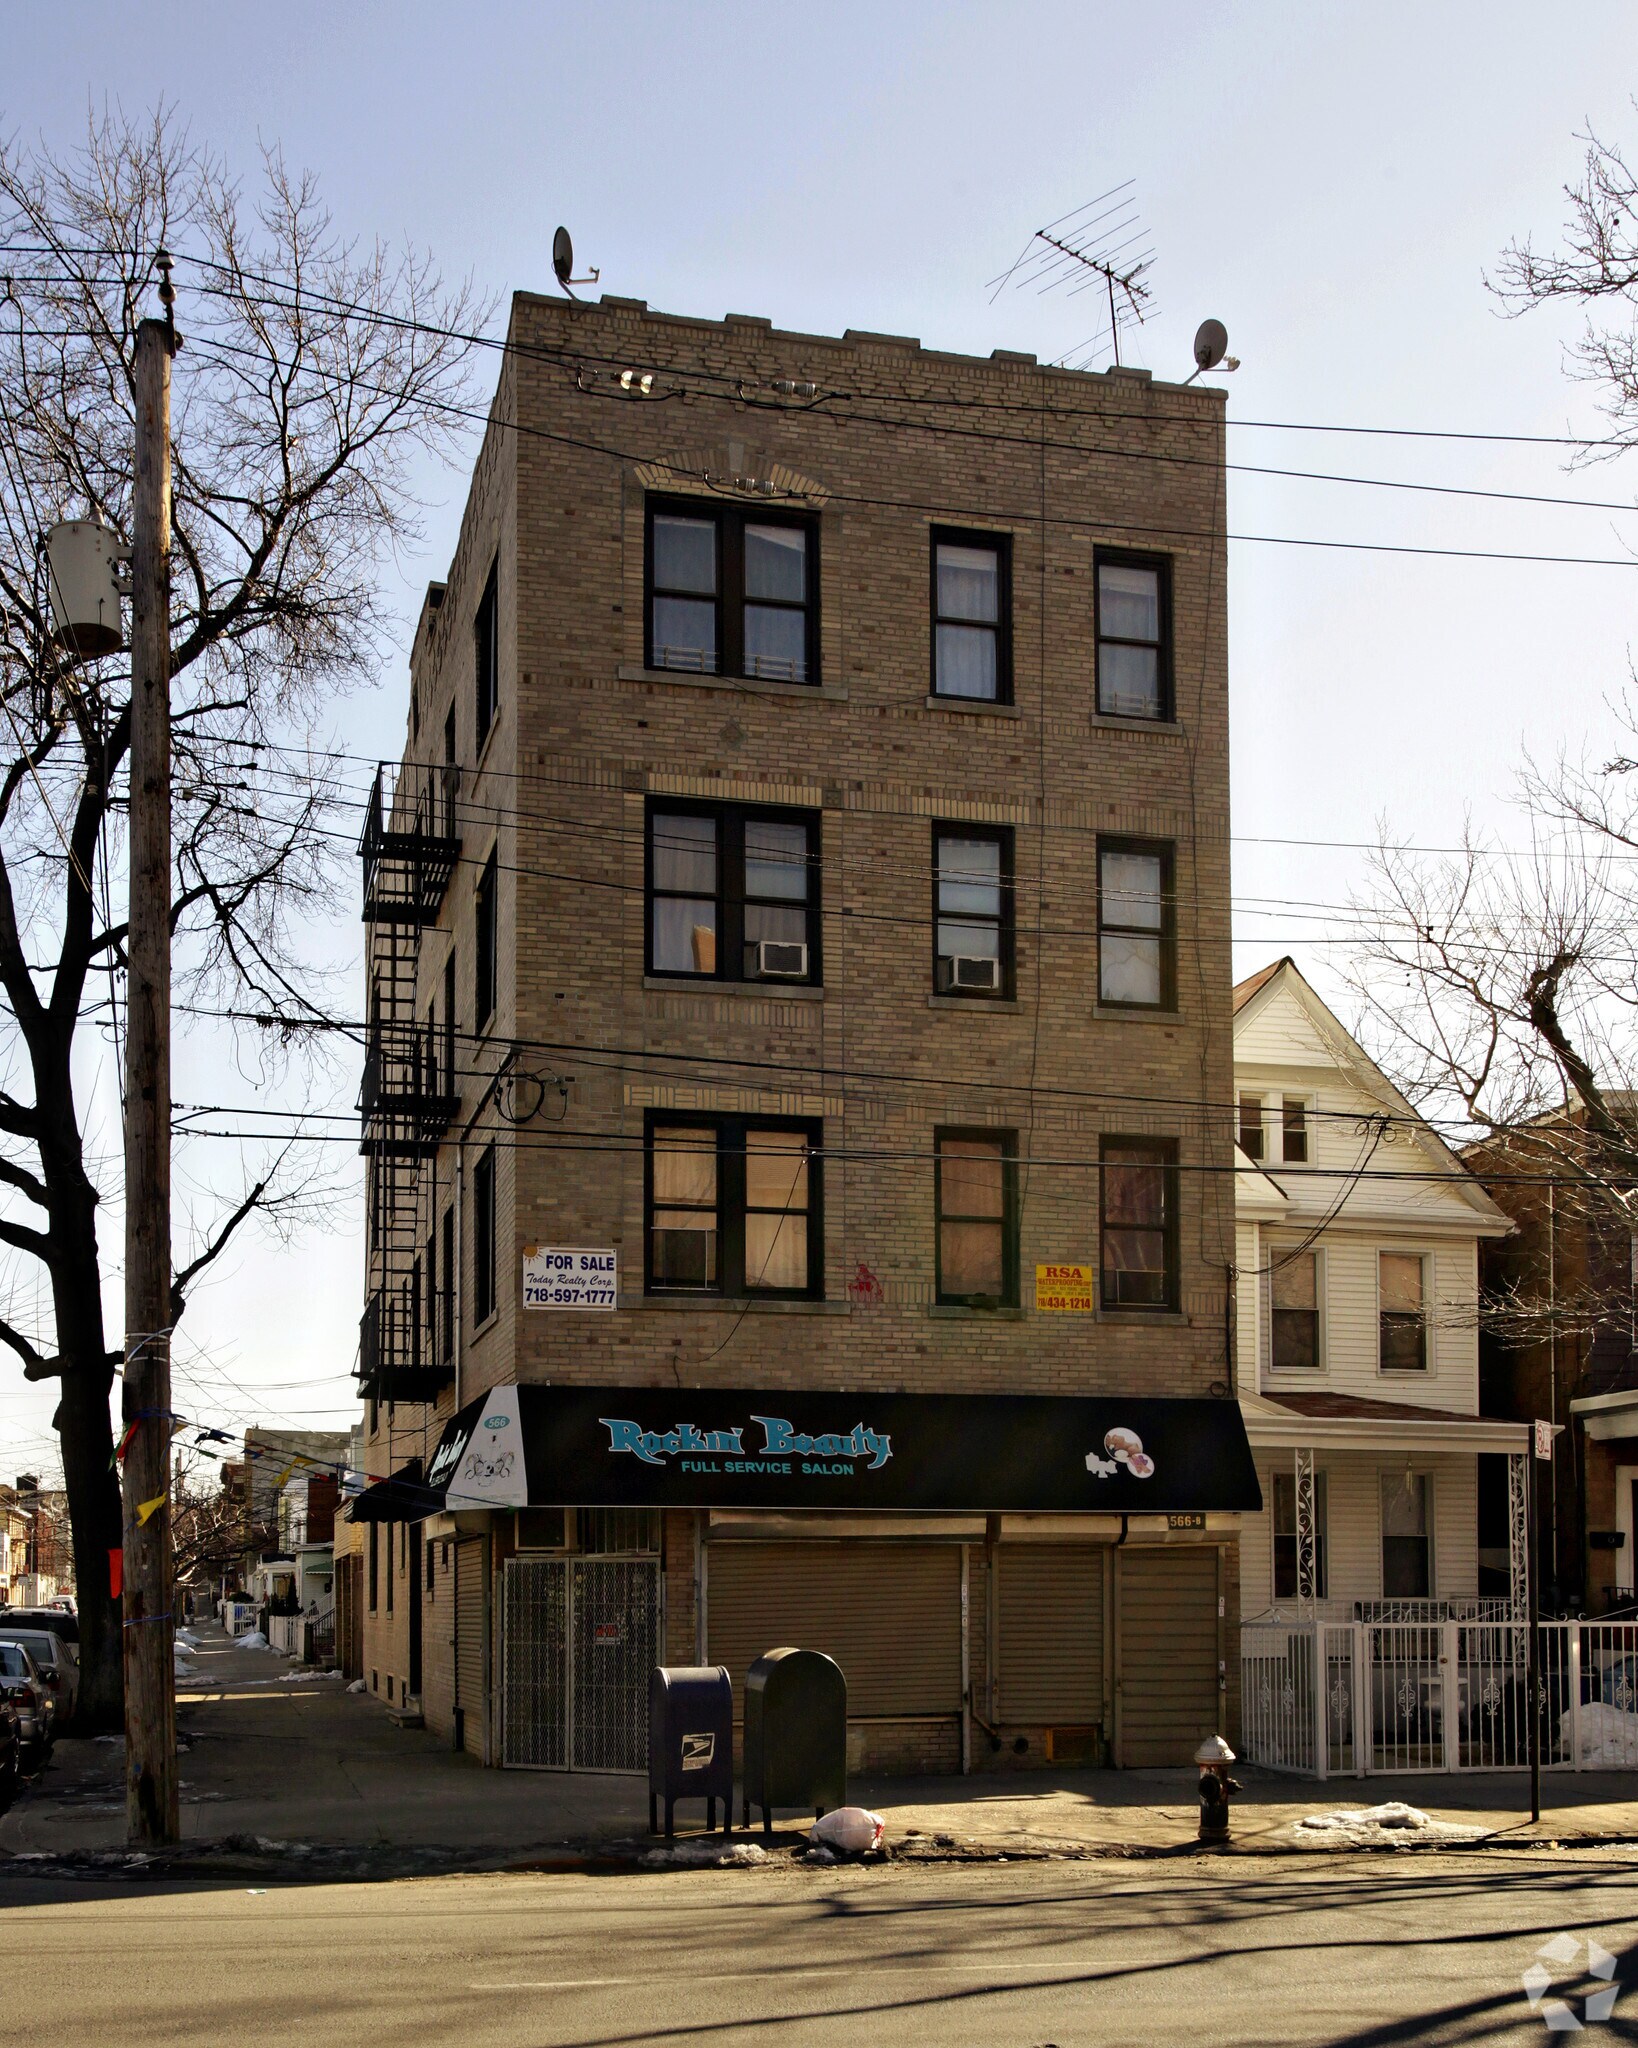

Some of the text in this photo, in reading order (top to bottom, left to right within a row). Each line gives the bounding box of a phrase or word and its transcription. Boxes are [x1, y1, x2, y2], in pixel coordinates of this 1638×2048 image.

[545, 1255, 615, 1271] FOR SALE
[1045, 1267, 1083, 1278] RSA
[526, 1273, 614, 1288] Today Realty Corp.
[525, 1288, 615, 1304] 718-597-1777
[1047, 1297, 1091, 1309] 434-1214
[488, 1417, 506, 1428] 566
[750, 1415, 893, 1469] Beauty
[681, 1461, 854, 1475] FULL SERVICE SALON
